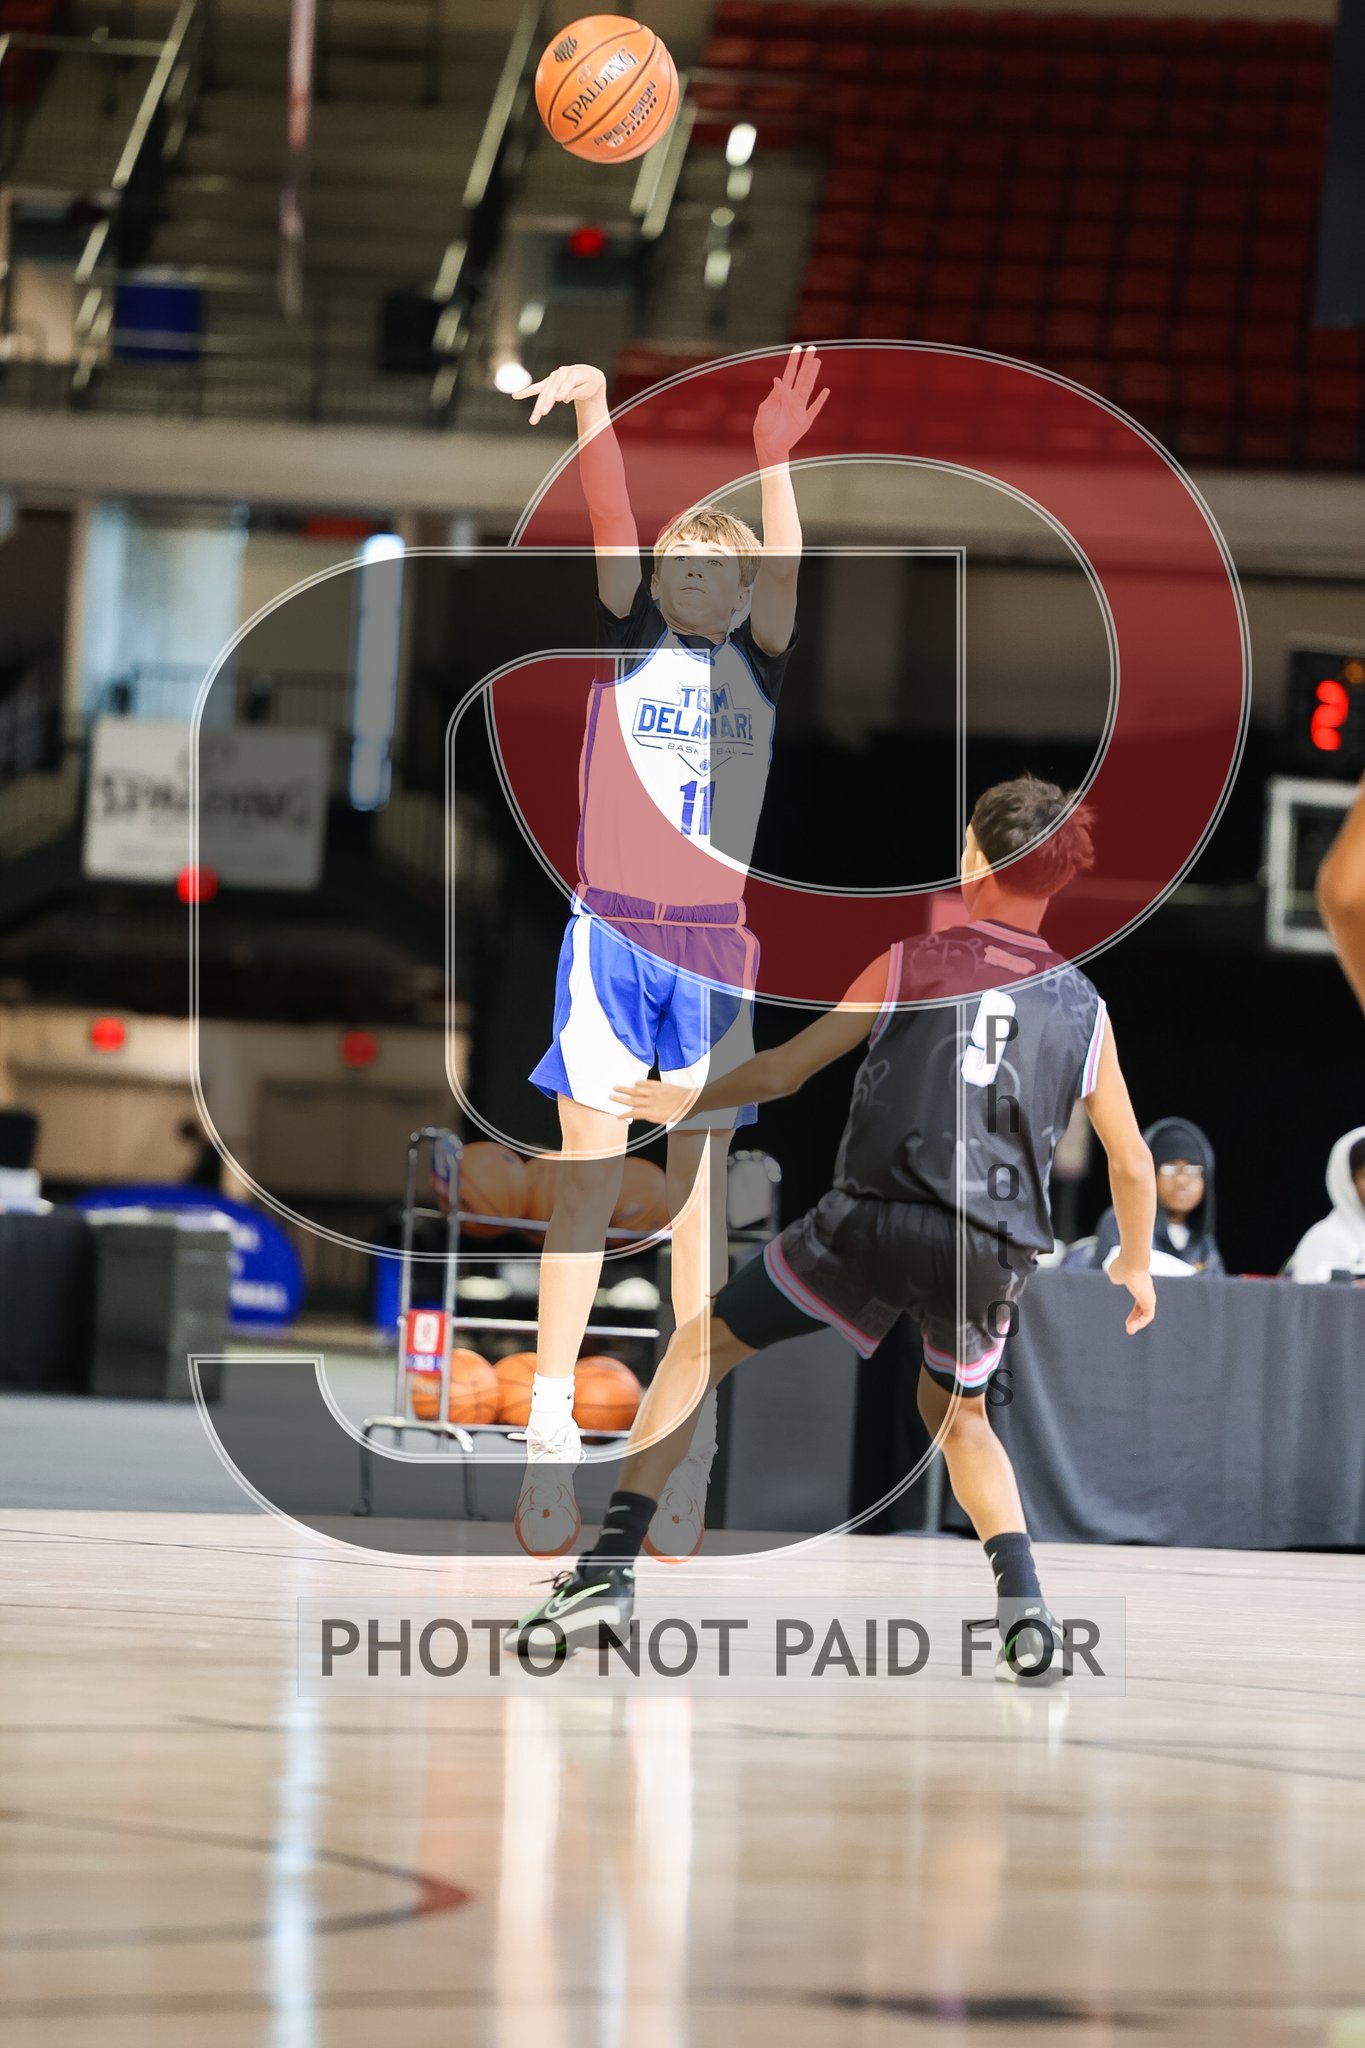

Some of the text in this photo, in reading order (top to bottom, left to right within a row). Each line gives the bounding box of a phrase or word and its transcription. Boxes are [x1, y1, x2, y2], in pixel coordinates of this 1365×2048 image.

[562, 47, 640, 129] SPALDING
[594, 80, 656, 146] PRECISION
[680, 780, 716, 835] 11
